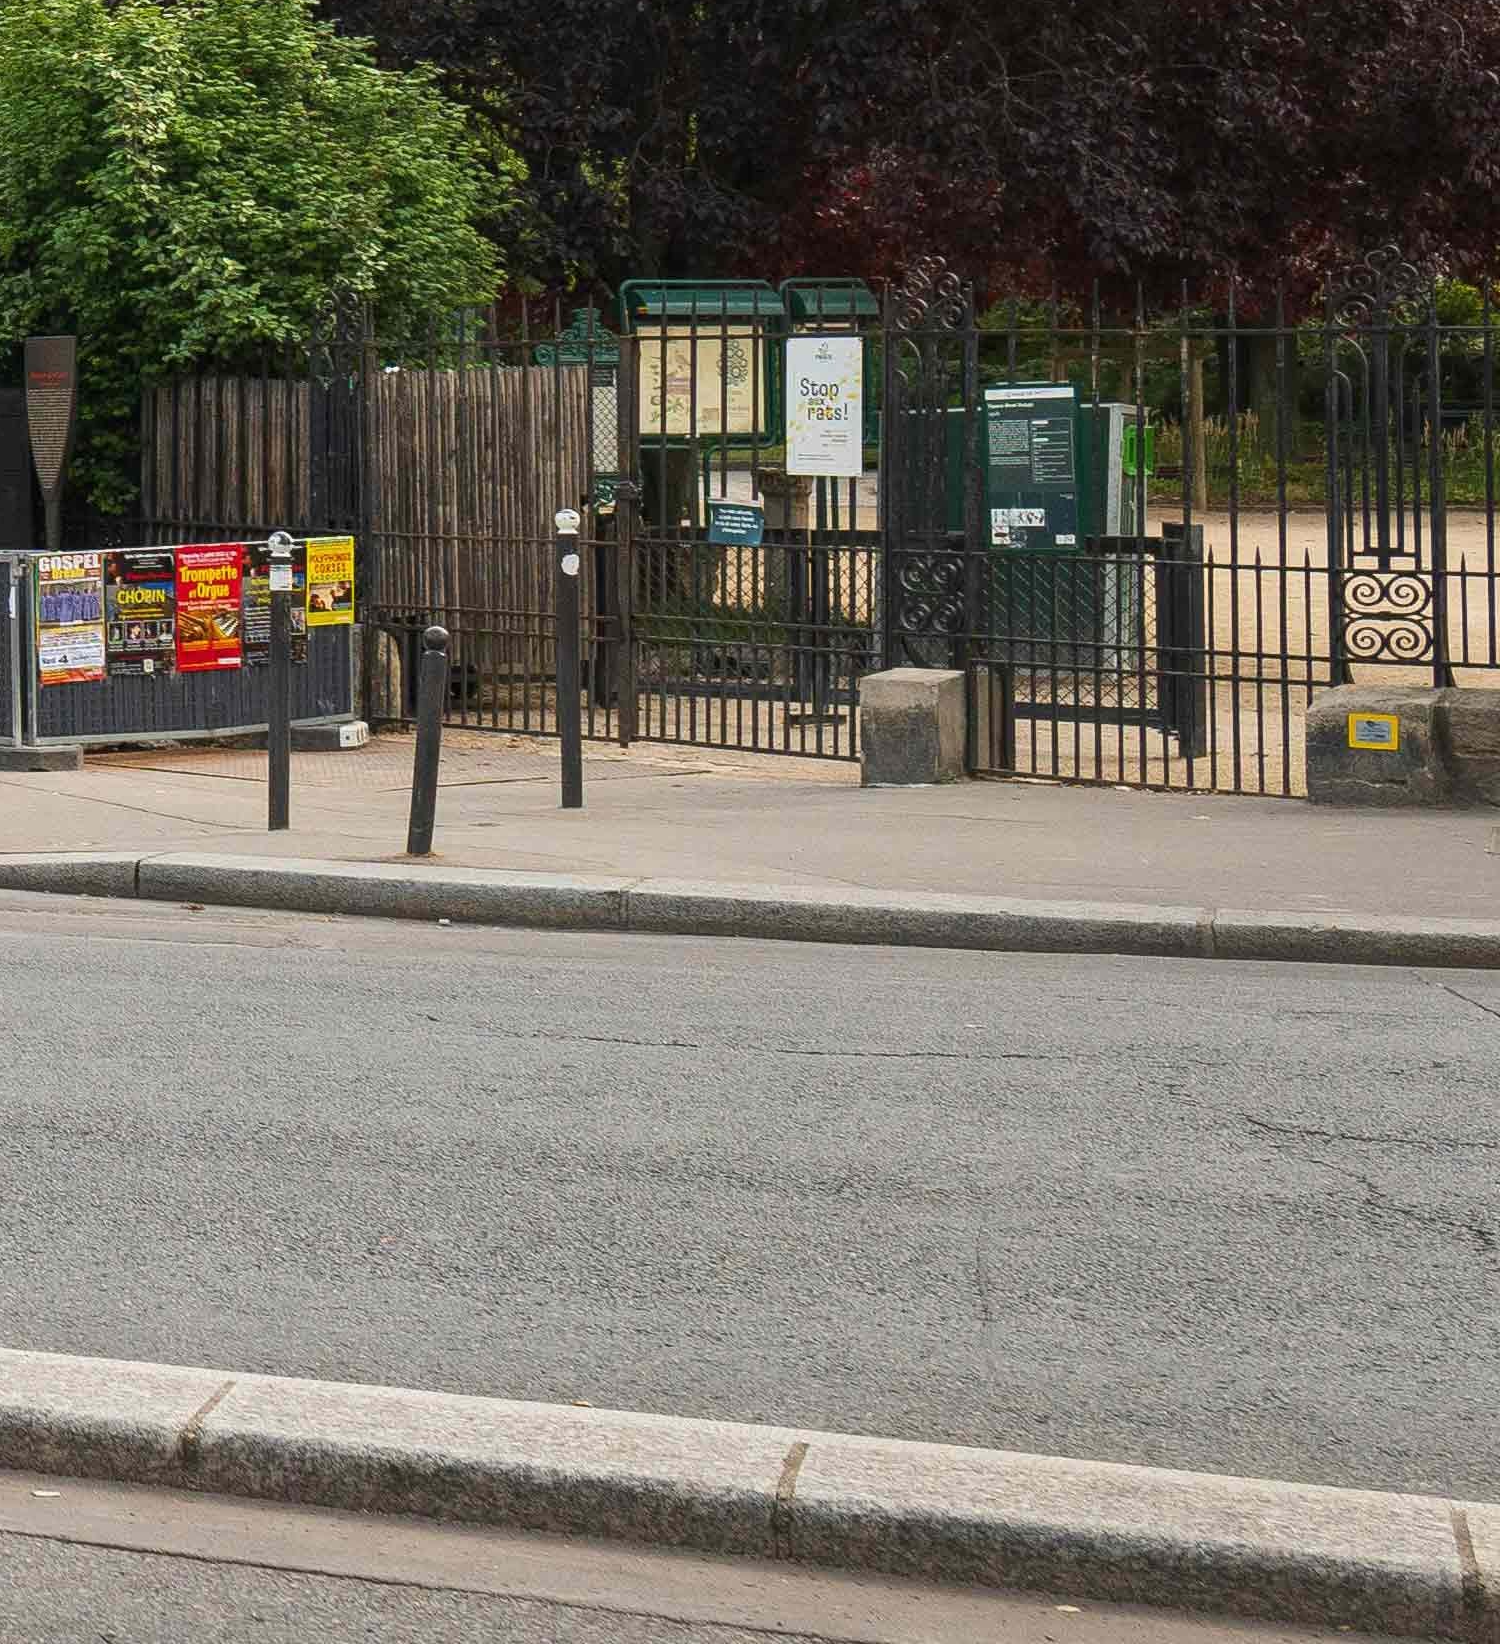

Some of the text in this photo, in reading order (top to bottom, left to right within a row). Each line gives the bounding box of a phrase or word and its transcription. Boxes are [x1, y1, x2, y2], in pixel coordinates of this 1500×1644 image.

[800, 377, 839, 401] Stop
[807, 402, 849, 421] rats!
[39, 553, 99, 572] GOSPEL
[180, 565, 238, 584] Trompette
[117, 589, 166, 605] CHOPIN
[197, 583, 230, 600] Orgue
